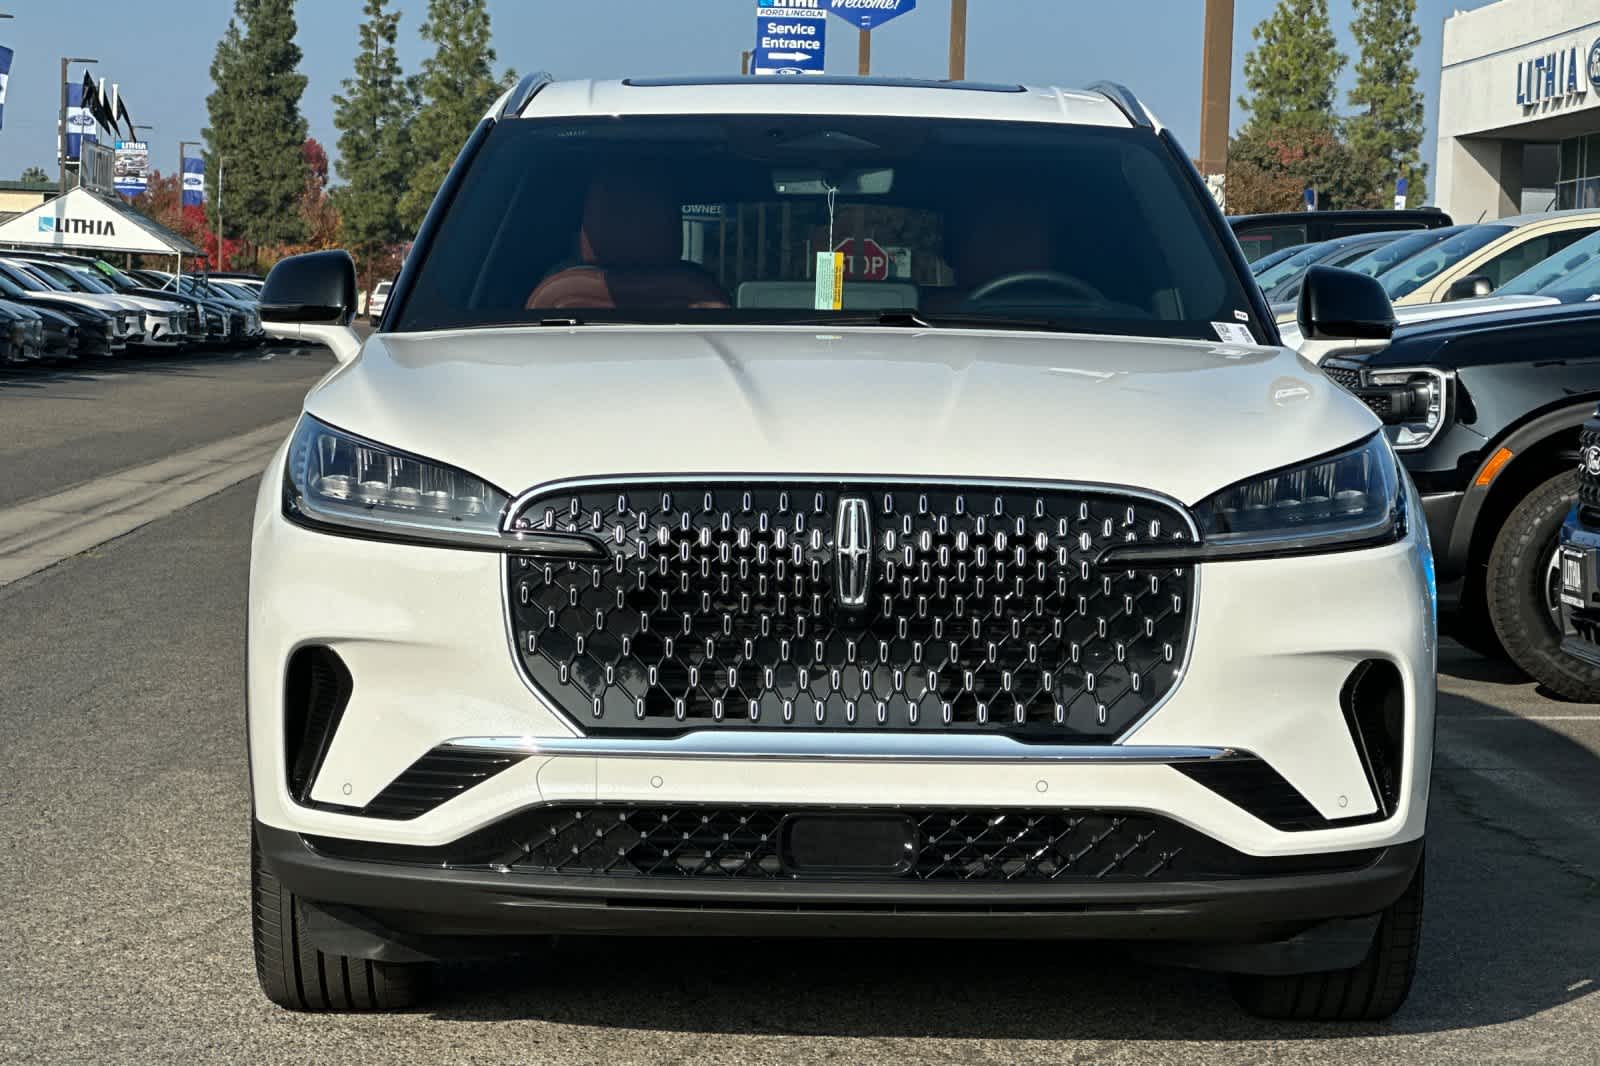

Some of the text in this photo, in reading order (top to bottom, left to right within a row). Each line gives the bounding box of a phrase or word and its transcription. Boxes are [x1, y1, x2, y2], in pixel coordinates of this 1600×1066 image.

[767, 22, 816, 35] Service
[762, 37, 820, 50] Entrance
[1516, 46, 1588, 105] LITHIA
[682, 205, 720, 213] OWNE
[56, 218, 115, 236] LITHIA
[843, 256, 884, 274] TP
